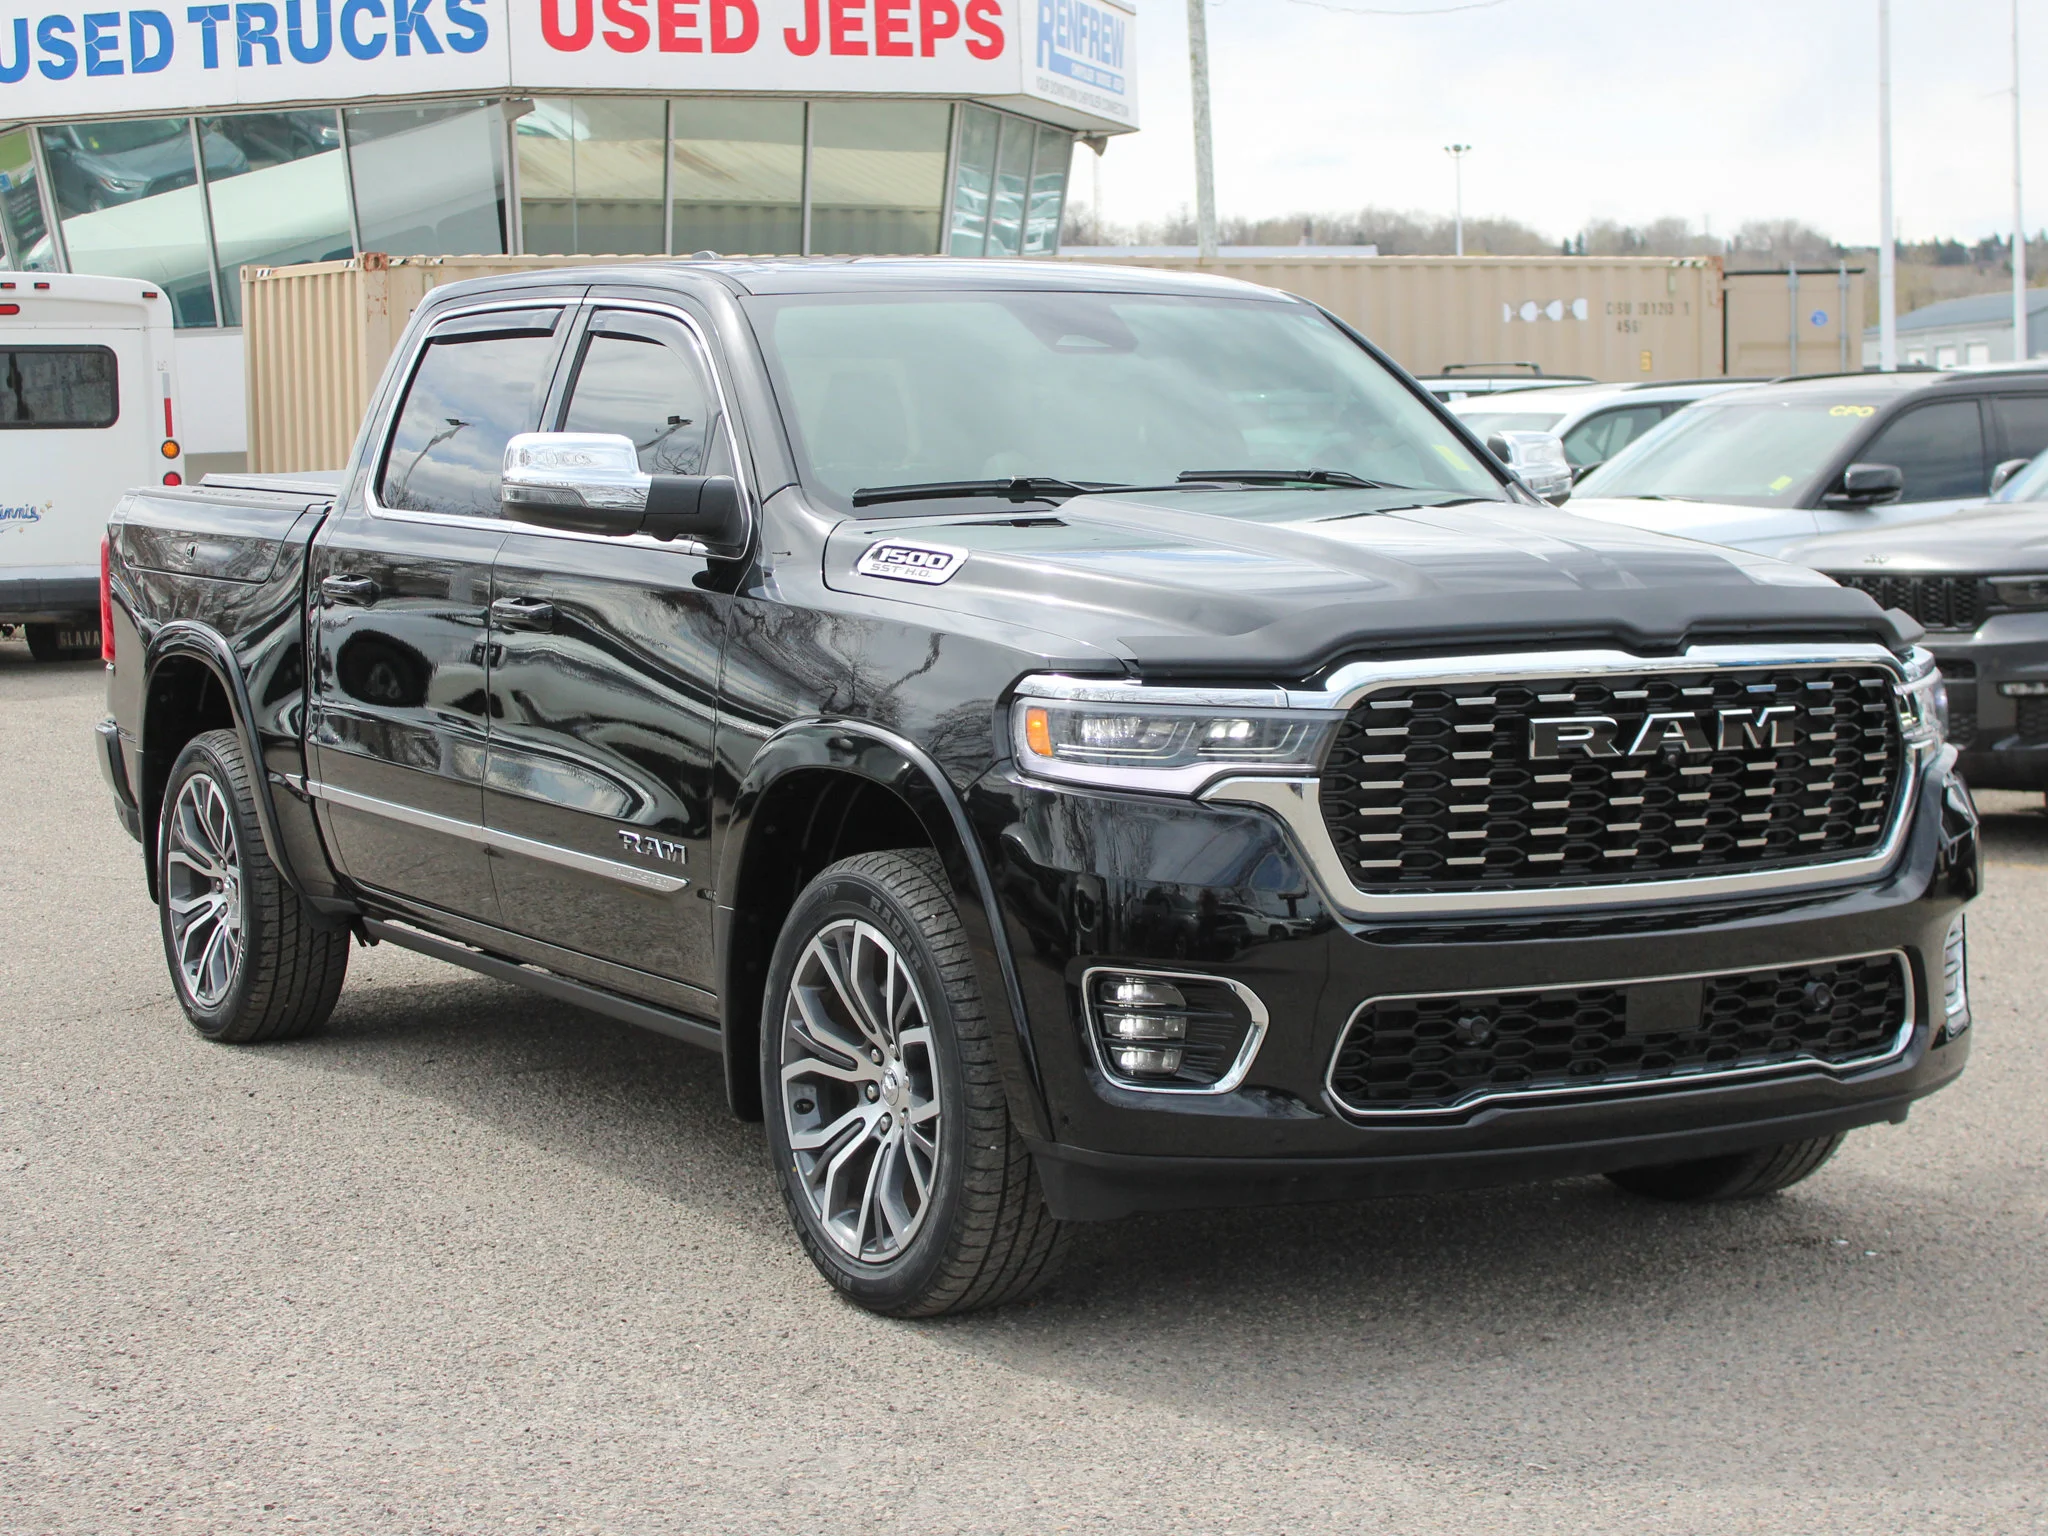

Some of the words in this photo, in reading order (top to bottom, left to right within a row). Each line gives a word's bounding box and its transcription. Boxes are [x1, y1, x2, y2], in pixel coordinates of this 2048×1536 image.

[0, 9, 174, 84] USED
[187, 0, 489, 69] TRUCKS
[541, 0, 759, 54] USED
[784, 0, 1005, 60] JEEPS
[1036, 0, 1125, 69] RENFREW
[870, 563, 902, 573] SST
[879, 546, 953, 570] 1500
[1529, 705, 1796, 760] RAM
[618, 829, 687, 865] RAM
[869, 895, 922, 970] RADAR
